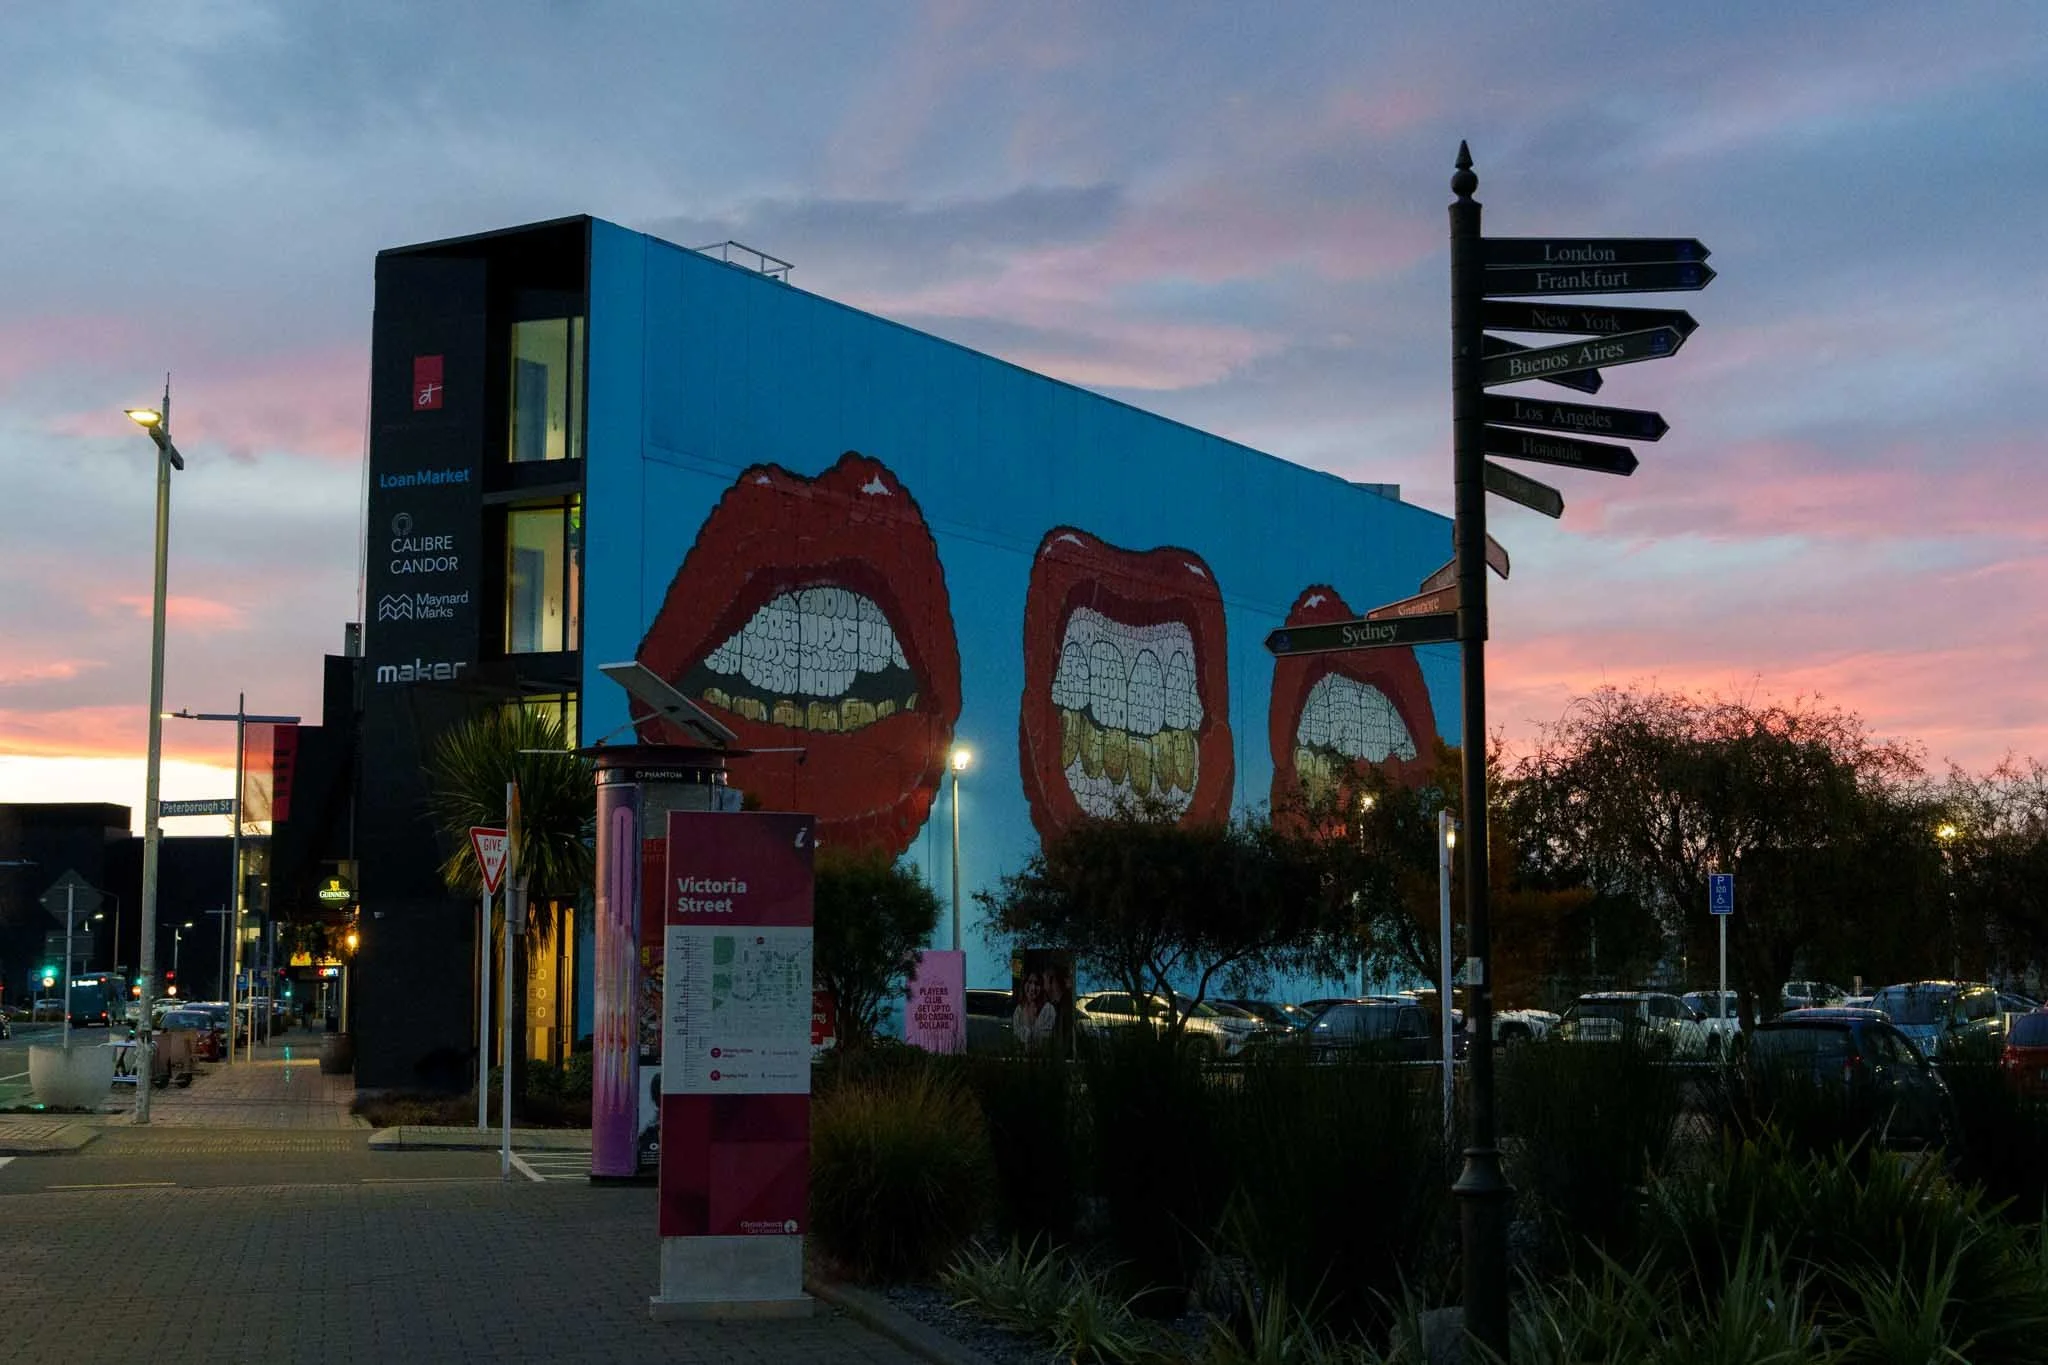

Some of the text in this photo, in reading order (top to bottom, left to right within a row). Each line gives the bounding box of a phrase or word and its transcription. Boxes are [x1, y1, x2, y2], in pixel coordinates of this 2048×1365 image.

[1544, 243, 1616, 262] London
[1536, 270, 1629, 290] Frankfurt
[1531, 309, 1621, 331] New York
[1509, 342, 1625, 377] Buenos Aires
[1513, 400, 1613, 431] Los Angeles
[1520, 436, 1583, 462] Honolulu
[391, 536, 454, 554] CALIBRE
[390, 556, 459, 575] CANDOR
[416, 591, 469, 608] Maynard
[416, 606, 455, 619] Marks
[1342, 623, 1398, 648] Sydney
[377, 657, 468, 683] maker
[645, 770, 684, 779] PHANTOM
[162, 800, 230, 815] Peterborough St
[484, 838, 503, 852] GIVE
[677, 876, 748, 894] Victoria
[319, 890, 351, 899] GUINNESS
[677, 897, 734, 913] Street
[919, 987, 949, 996] PLAYERS
[924, 996, 943, 1004] CLUB
[917, 1004, 951, 1012] GET UP TO
[928, 1012, 954, 1021] CASINO
